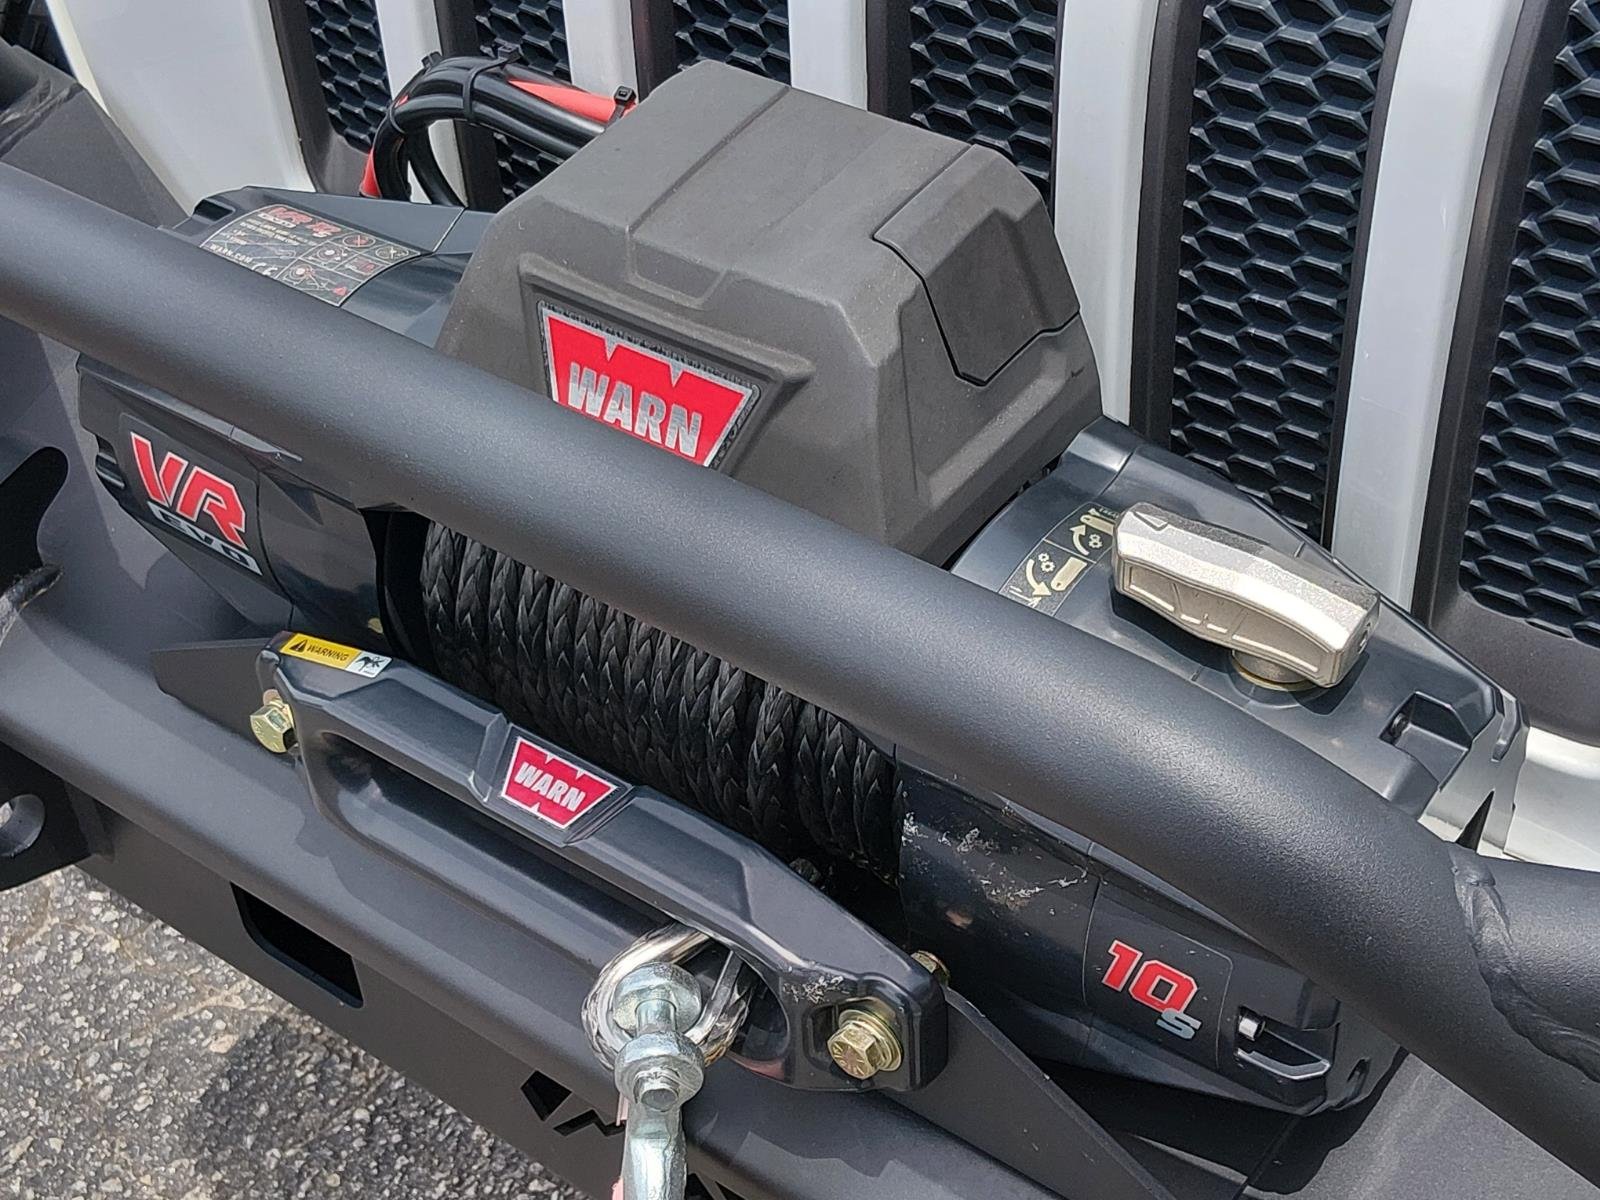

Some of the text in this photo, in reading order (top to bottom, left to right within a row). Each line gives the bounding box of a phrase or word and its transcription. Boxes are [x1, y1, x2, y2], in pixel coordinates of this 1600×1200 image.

[567, 361, 702, 457] WARN
[130, 431, 248, 550] VR
[153, 506, 257, 572] EVO
[306, 644, 349, 661] WARNING
[514, 761, 586, 812] WARN
